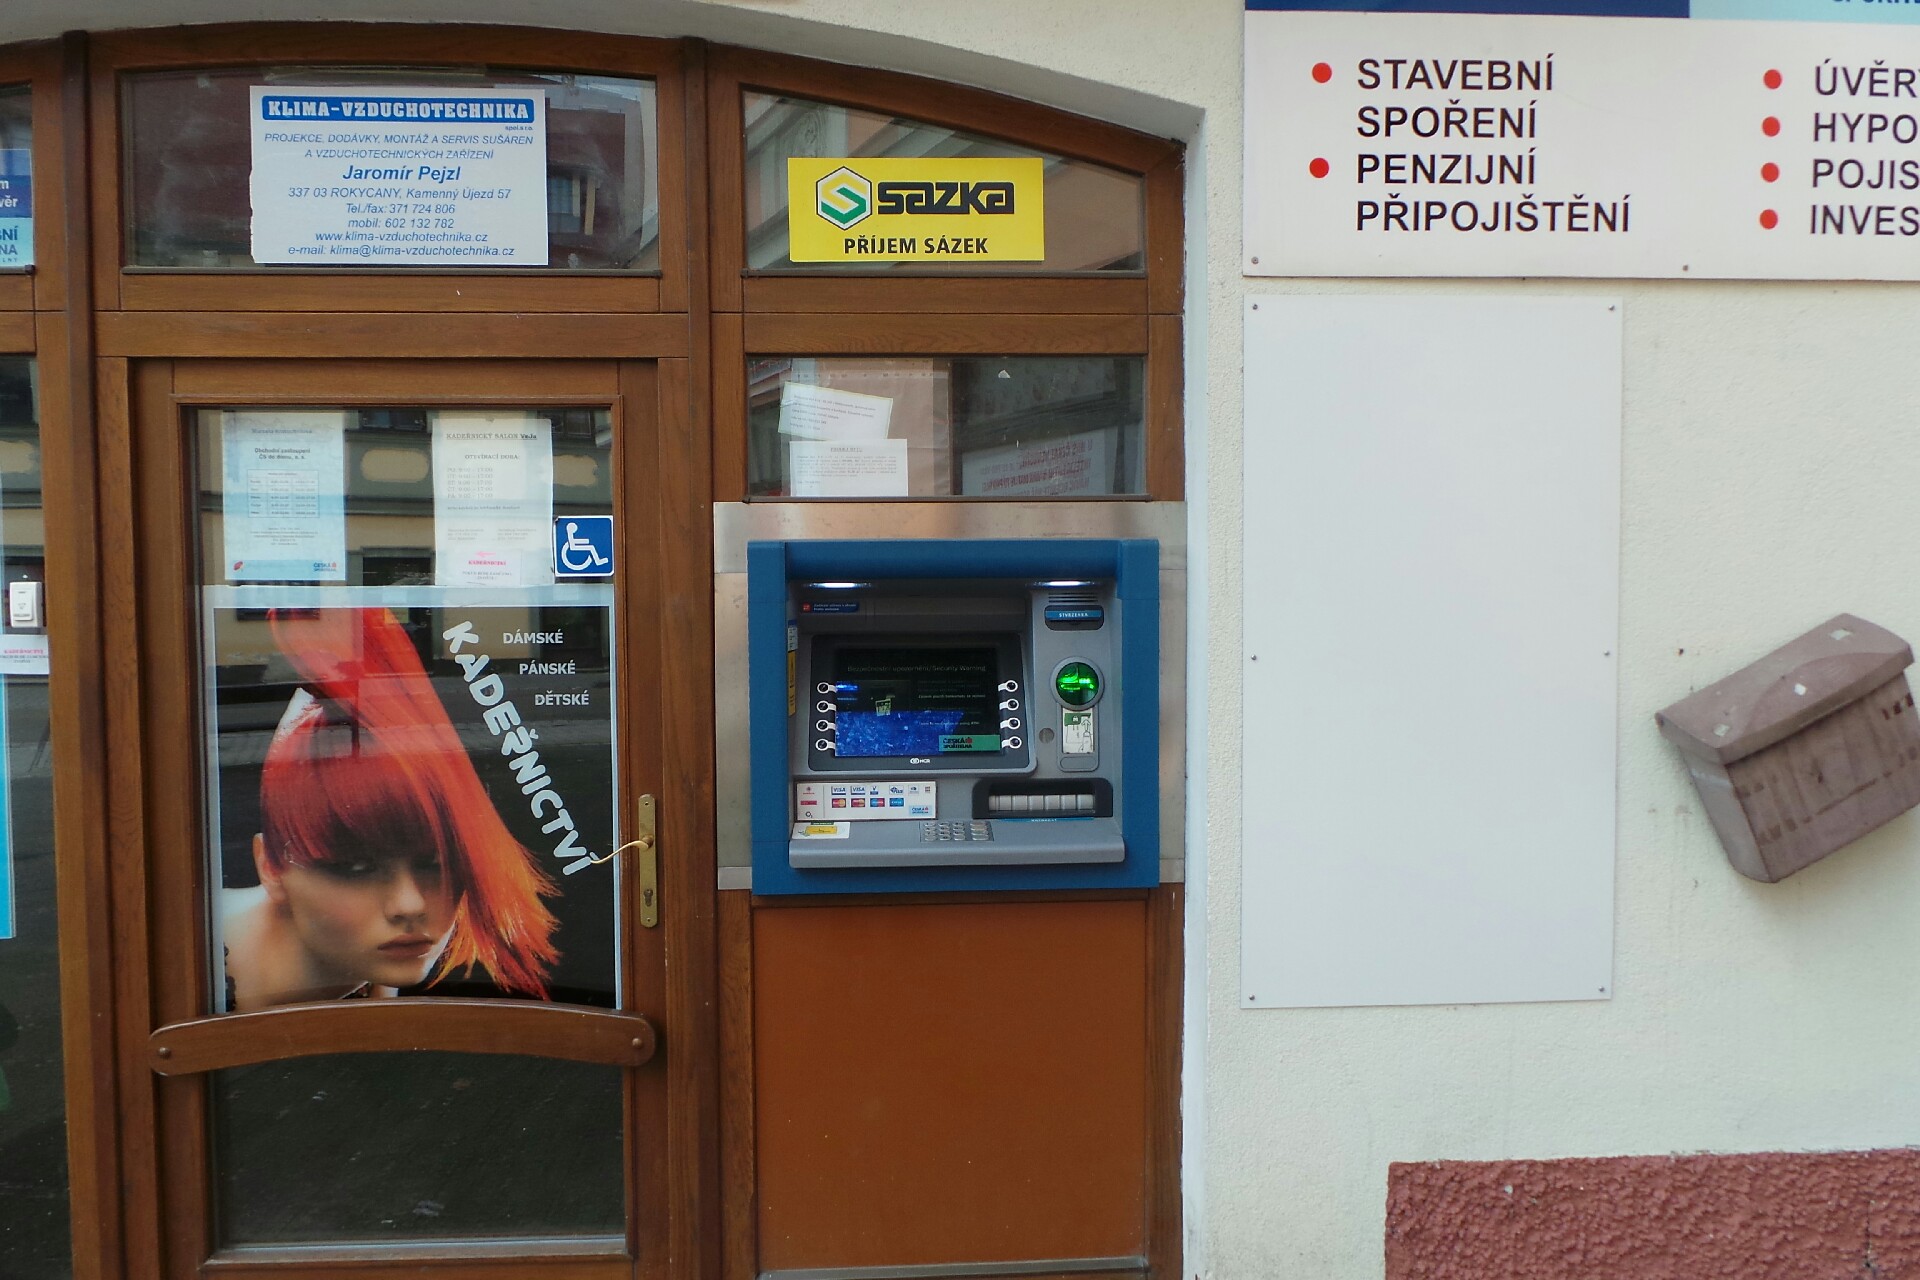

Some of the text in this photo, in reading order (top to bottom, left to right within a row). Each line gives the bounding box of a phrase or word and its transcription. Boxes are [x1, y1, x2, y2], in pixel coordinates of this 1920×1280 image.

[1356, 52, 1555, 91] STAVEBNÍ
[1814, 57, 1920, 98] ÚVĚR
[268, 100, 529, 120] KLIMA-VZDUCHOTECHNIKA
[1356, 98, 1538, 138] SPOŘENÍ
[1812, 112, 1919, 144] HYPO
[264, 132, 534, 145] PROJEKCE, DODÁVKY, MONTÁŽ A SERVIS SUŠÁREN
[304, 148, 494, 159] A VZDUCHOTECHNICKÝCH ZAŘÍZENÍ
[342, 164, 461, 184] Jaromír Pejzl
[1356, 146, 1537, 185] PENZIJNÍ
[1811, 158, 1920, 190] POJIS
[288, 186, 511, 201] 337 03 ROKYCANY, Kamenný Újezd 57
[389, 203, 408, 214] 371
[412, 203, 431, 214] 724
[434, 203, 456, 214] 806
[1356, 192, 1631, 233] PŘIPOJIŠTĚNÍ
[347, 217, 455, 229] mobil: 602 132 782
[1809, 204, 1920, 236] INVES
[315, 231, 488, 242] www.klima-vzduchotechnika.cz
[844, 234, 989, 254] PŘÍJEM SÁZEK
[287, 244, 515, 258] e-mail: klima@klima-vzduchotechnika.cz
[502, 628, 564, 644] DÁMSKÉ
[518, 659, 576, 675] PÁNSKÉ
[534, 689, 590, 706] DĚTSKÉ
[442, 620, 600, 877] KADEŘNICTVÍ
